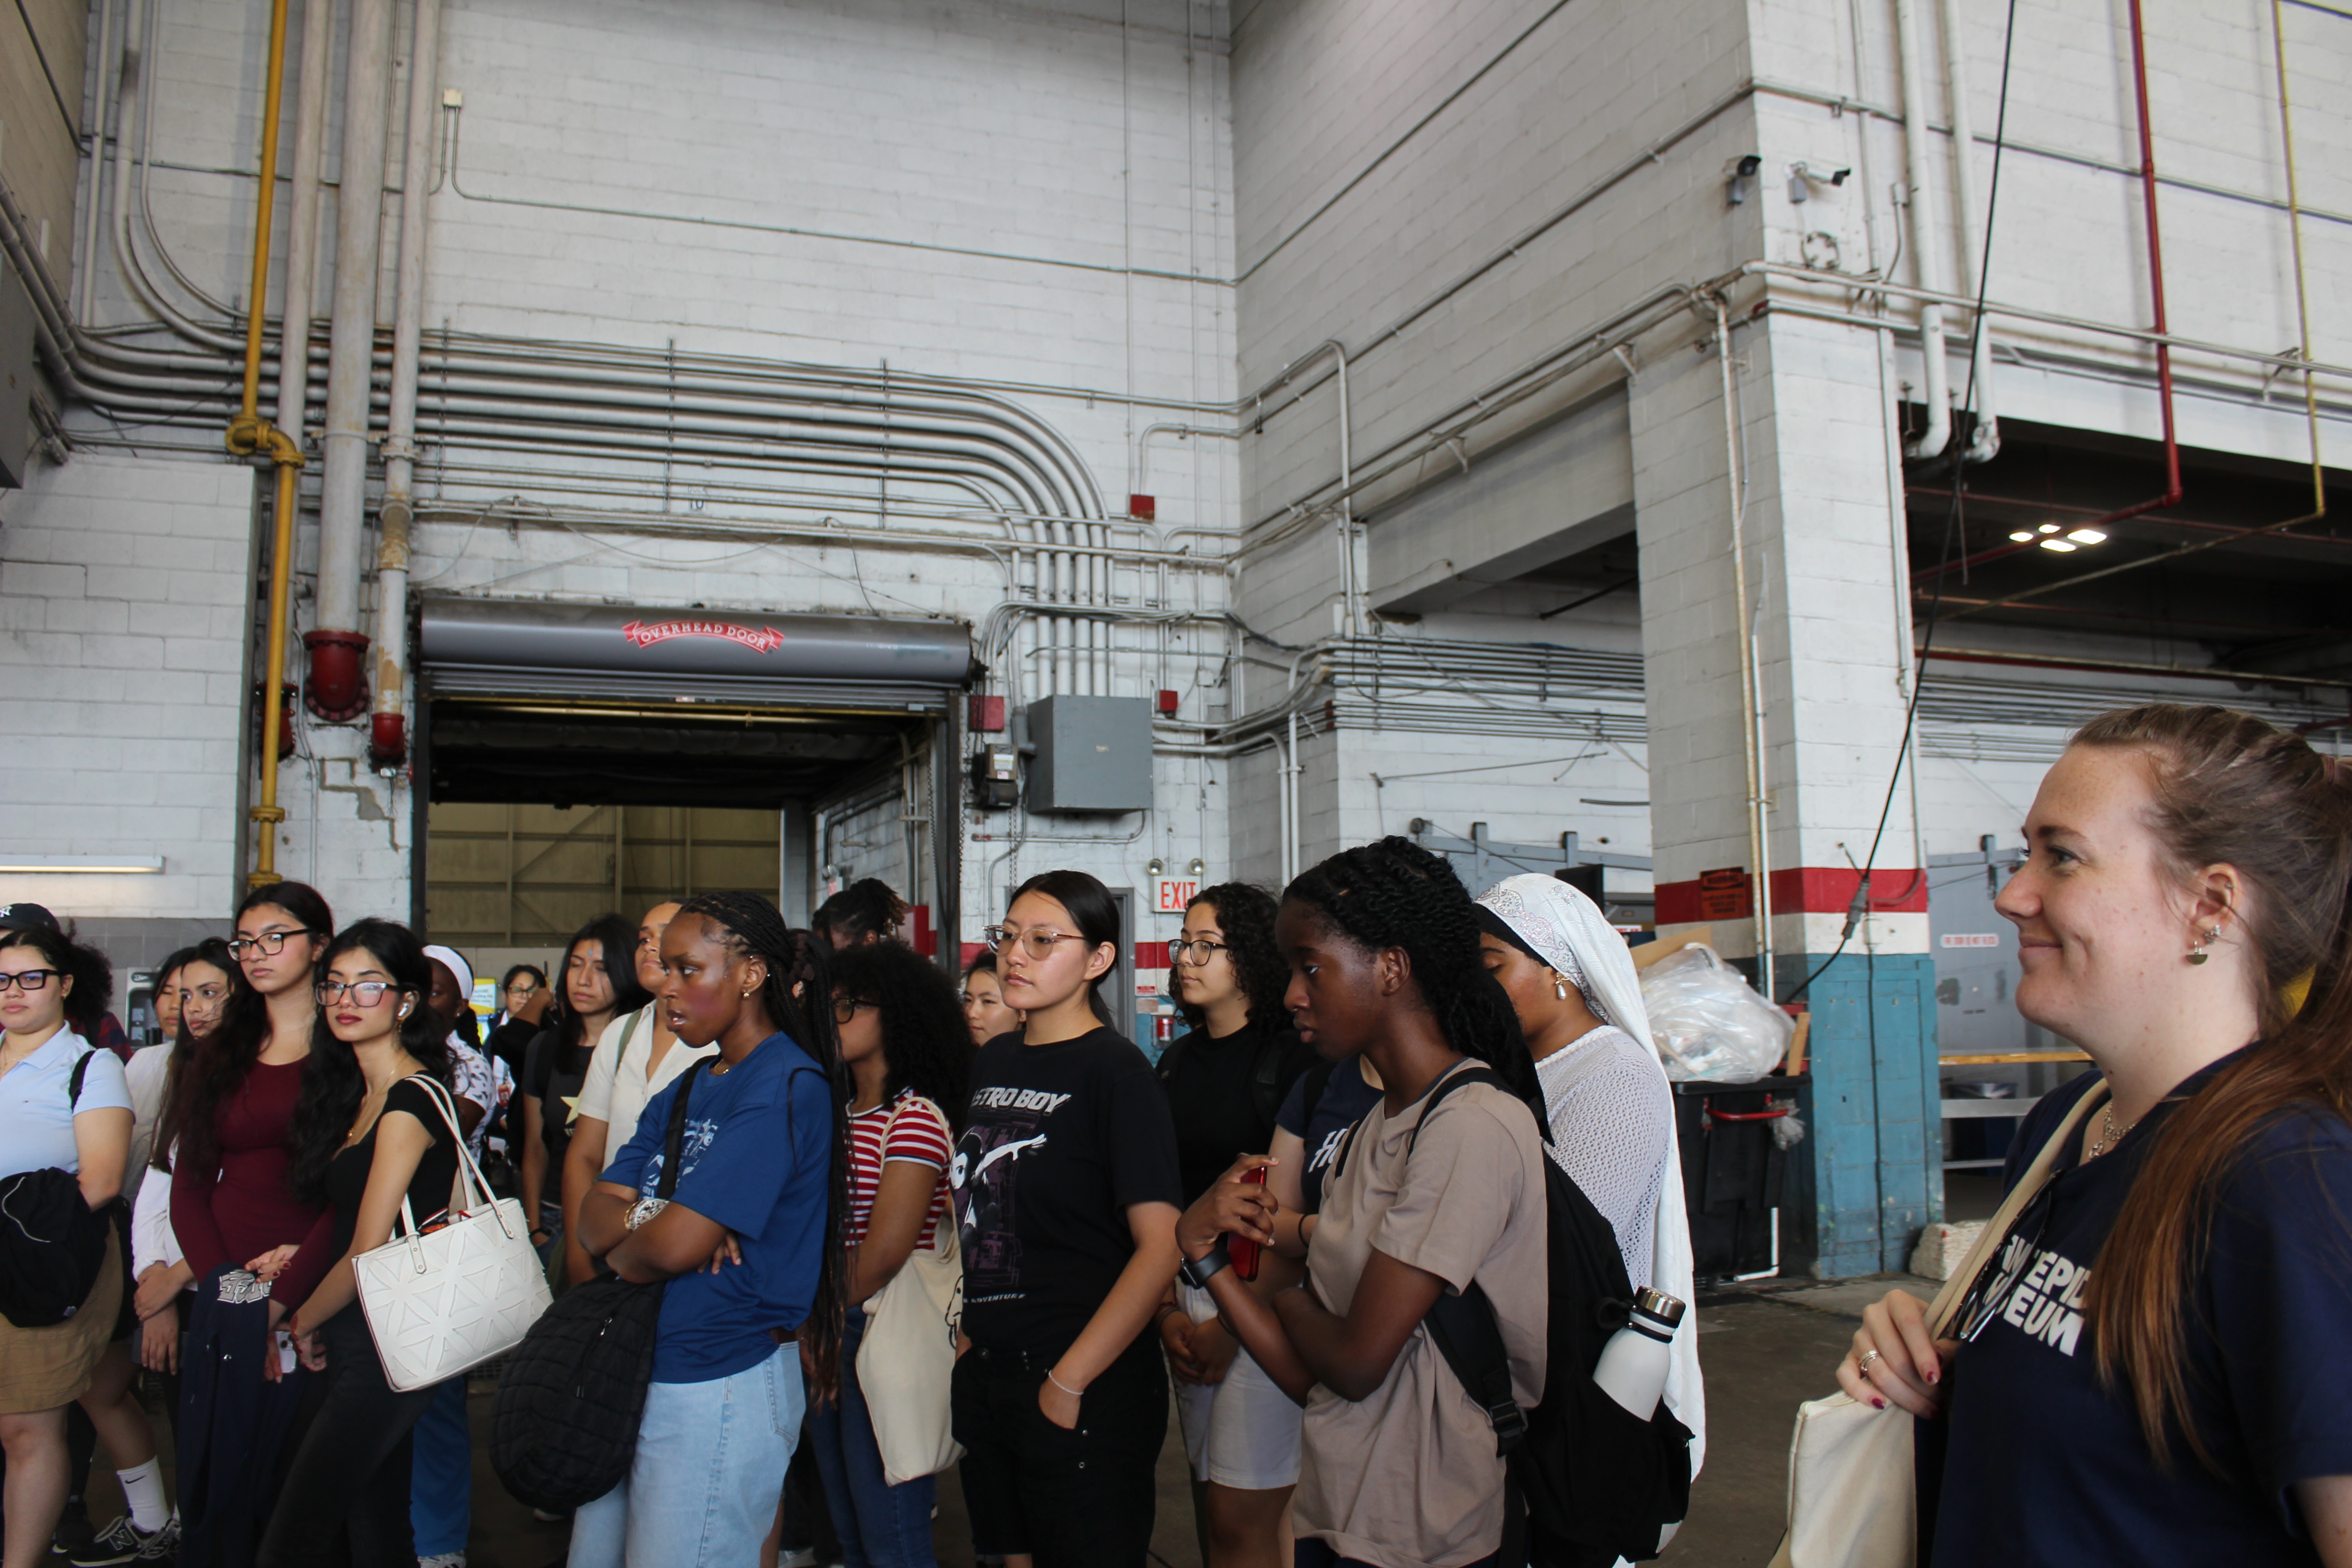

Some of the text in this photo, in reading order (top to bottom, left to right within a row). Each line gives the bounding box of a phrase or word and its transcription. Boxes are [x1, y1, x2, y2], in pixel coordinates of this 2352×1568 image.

[640, 622, 765, 649] OVERHEAD DOOR
[1161, 882, 1196, 909] EXIT
[1014, 1089, 1071, 1116] BOY
